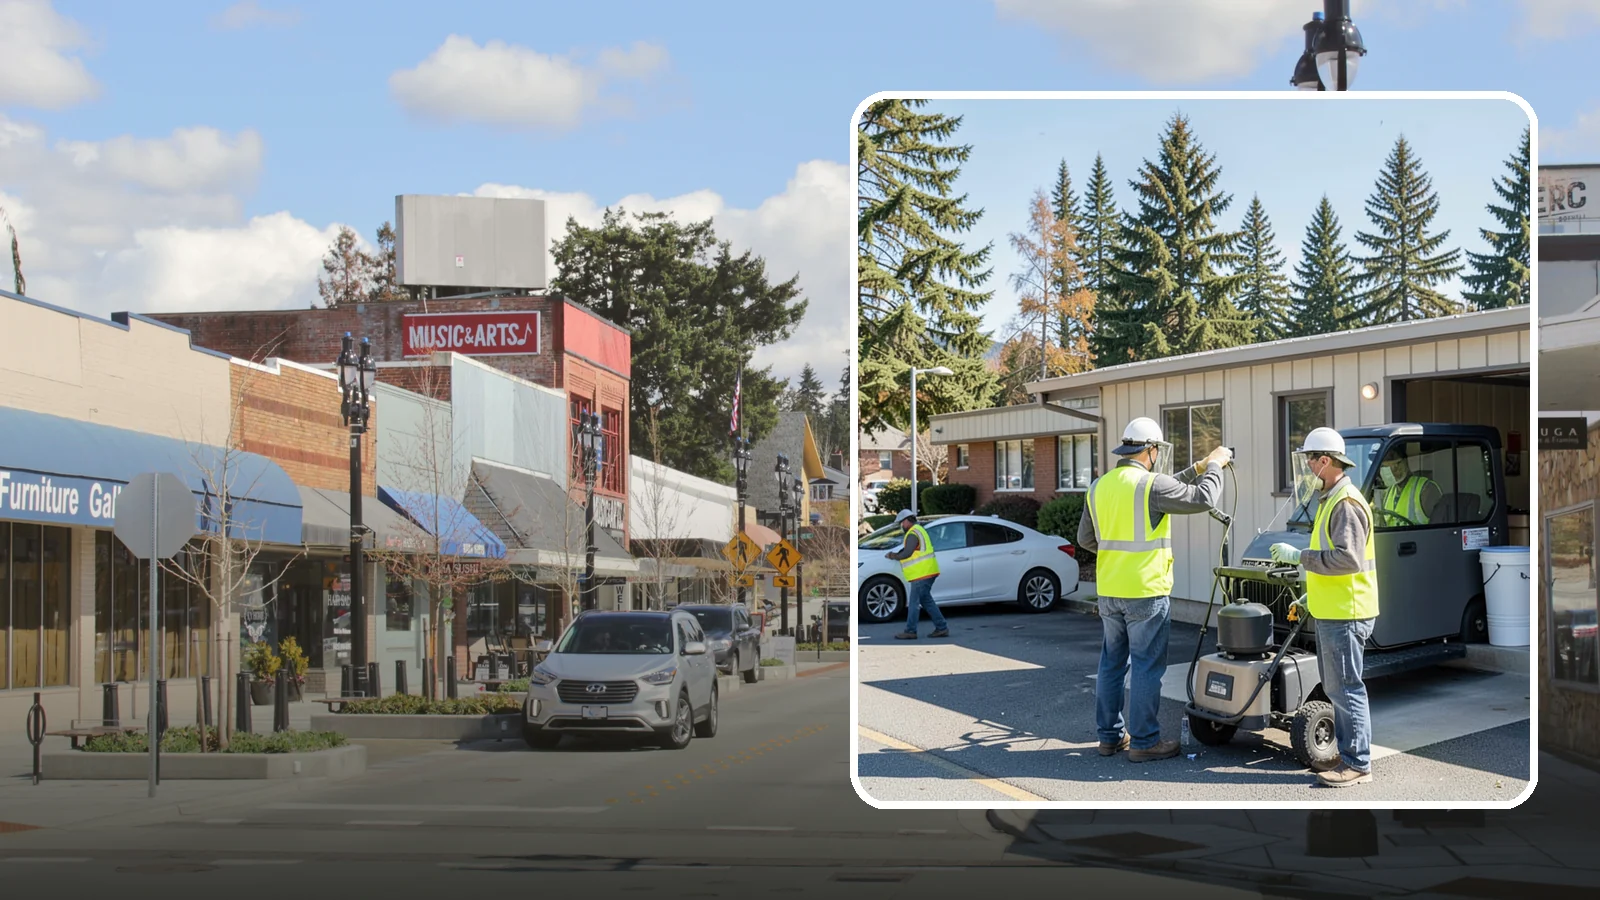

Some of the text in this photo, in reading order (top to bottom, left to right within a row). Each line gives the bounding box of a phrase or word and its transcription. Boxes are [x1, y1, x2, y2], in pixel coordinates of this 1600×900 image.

[1540, 428, 1577, 436] UGA
[0, 471, 79, 515] Furniture
[453, 563, 479, 574] SUSHI
